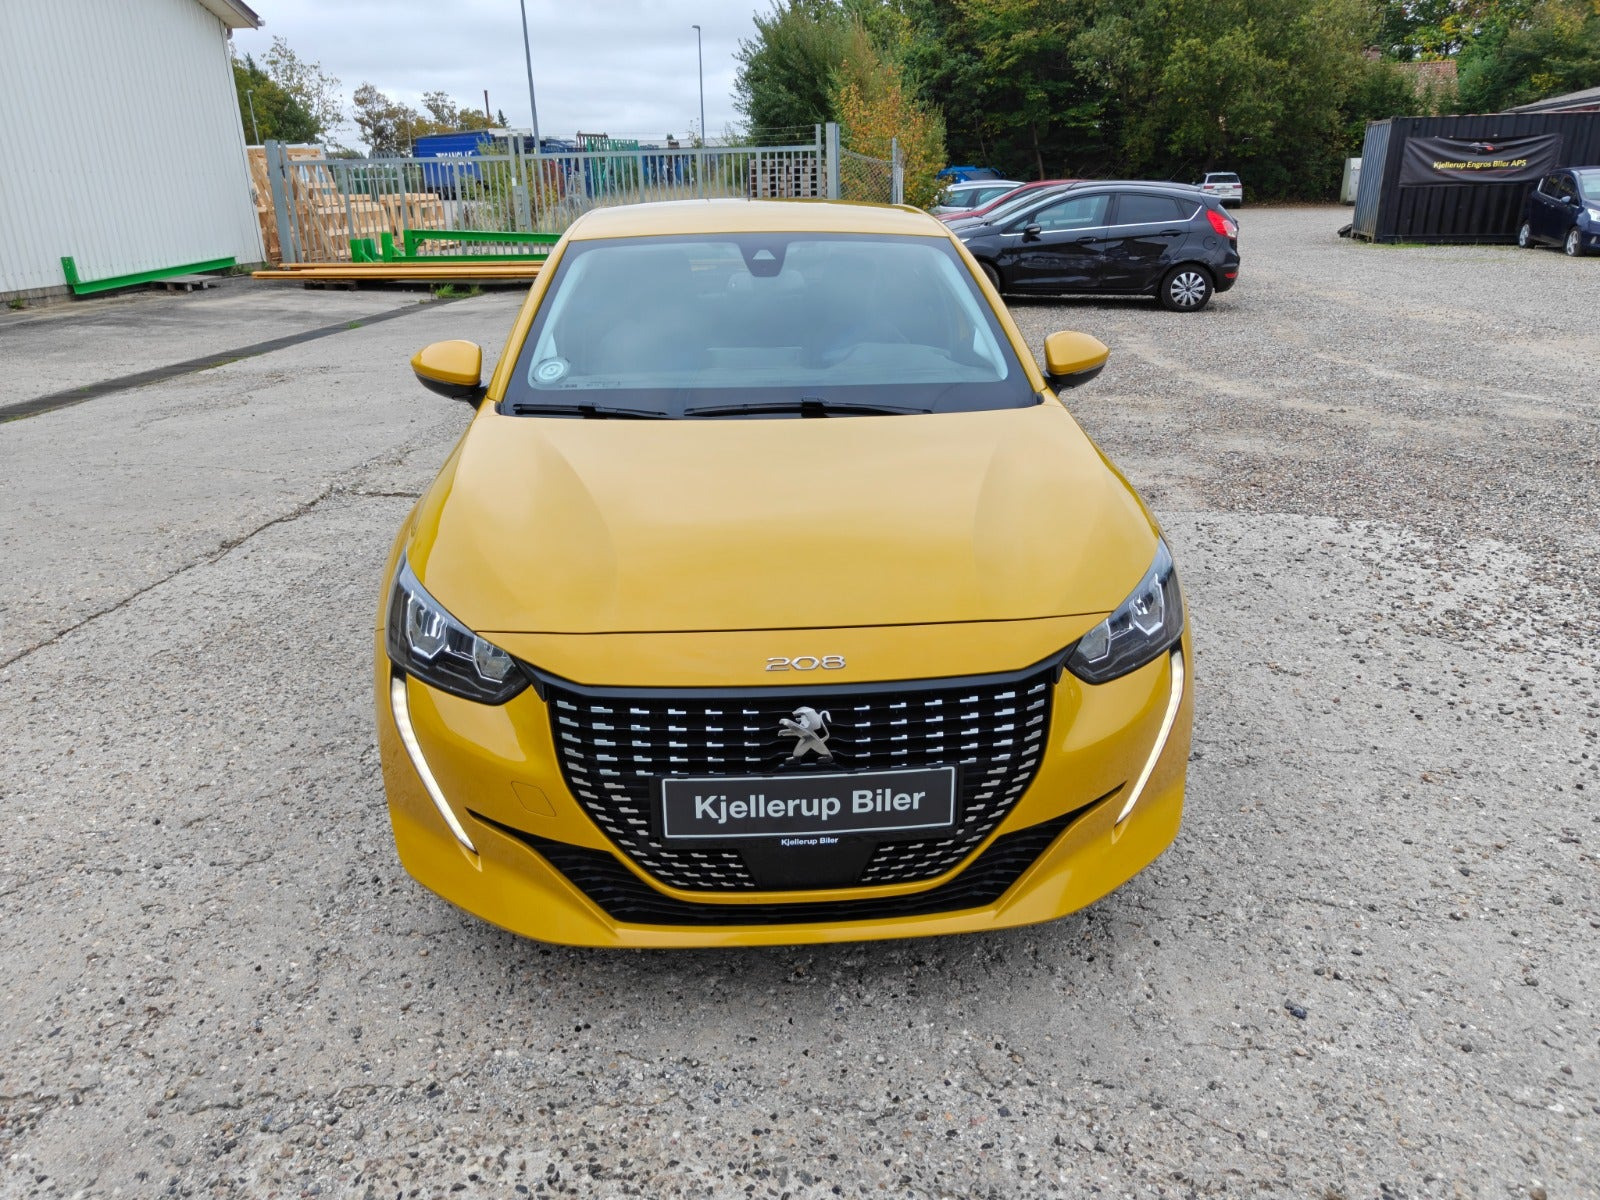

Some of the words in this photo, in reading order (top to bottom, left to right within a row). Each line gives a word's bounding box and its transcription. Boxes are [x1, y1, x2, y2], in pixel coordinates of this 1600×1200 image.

[1433, 161, 1466, 170] Kjellerup
[1467, 161, 1491, 169] Engros
[1511, 159, 1527, 167] APS
[765, 655, 847, 672] 208
[694, 794, 841, 824] Kjellerup
[852, 788, 926, 814] Biler
[781, 838, 818, 847] Kjellerup
[819, 836, 839, 844] Biler
